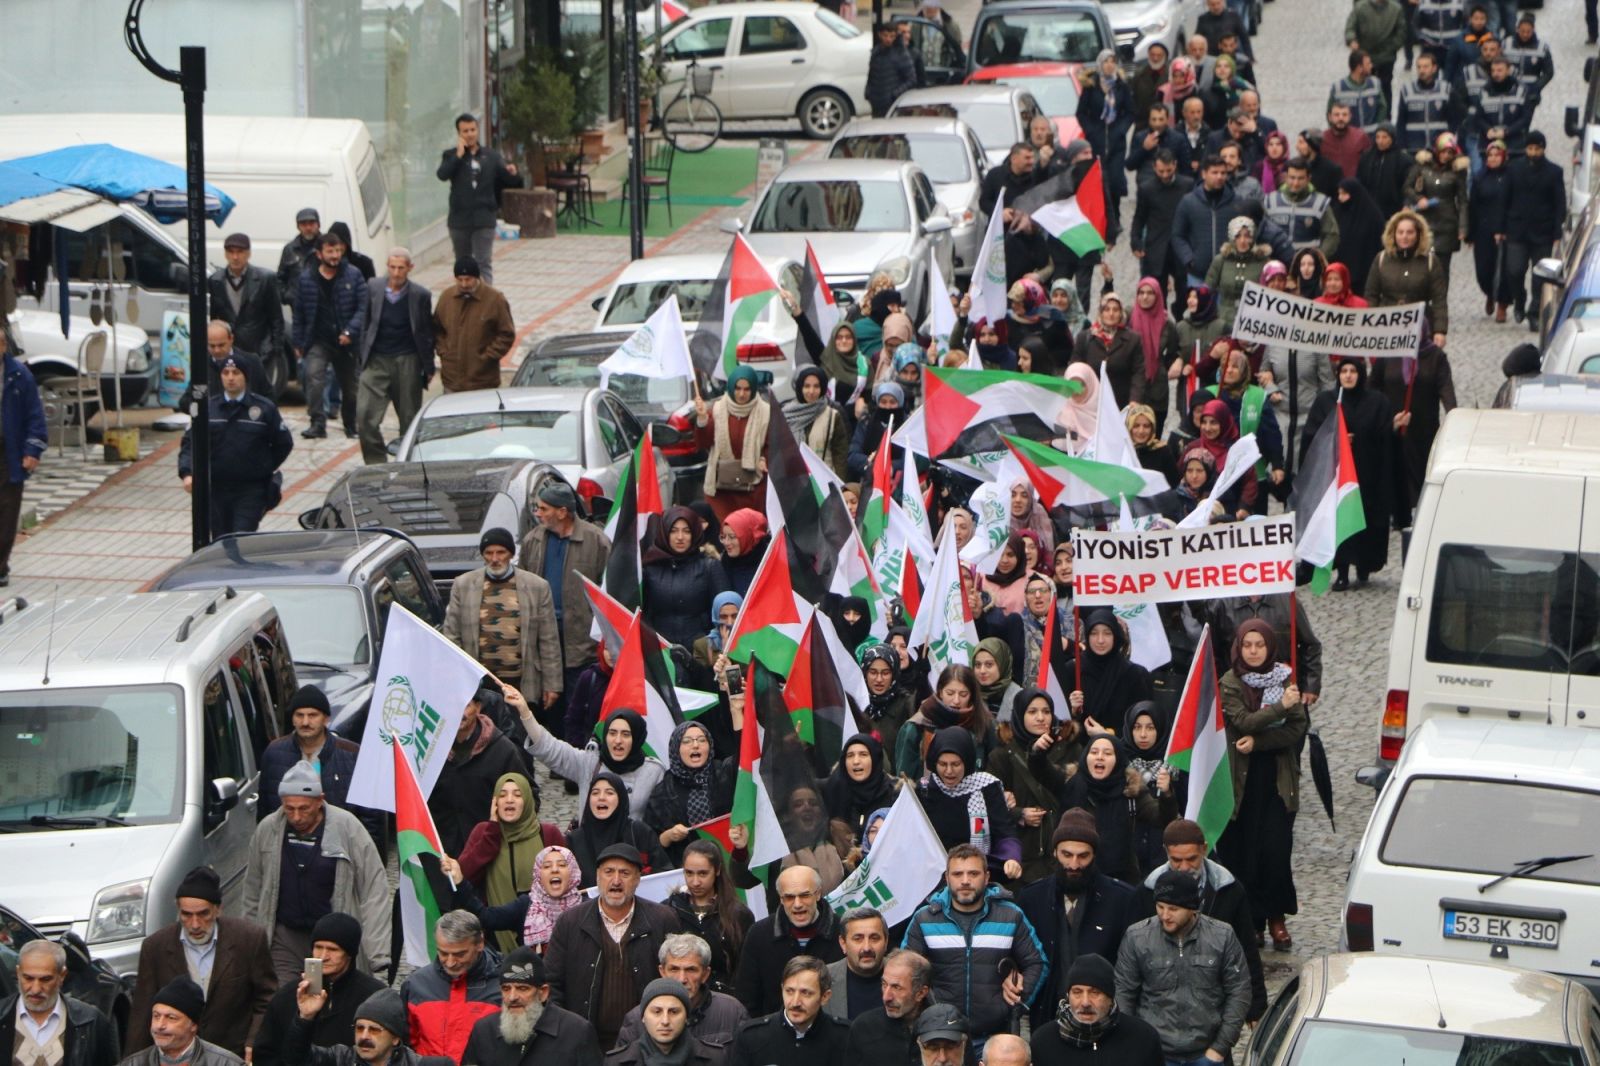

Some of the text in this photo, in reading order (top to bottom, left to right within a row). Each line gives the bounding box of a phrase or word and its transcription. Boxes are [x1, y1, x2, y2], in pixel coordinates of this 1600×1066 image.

[1244, 289, 1419, 330] SİYONİZME KARŞI
[1238, 315, 1417, 350] YAŞASIN İSLAMİ MÜCADELEMİZ
[1071, 523, 1293, 560] İYONİST KATİLLER
[1163, 559, 1294, 590] VERECEK
[1437, 675, 1494, 689] TRANSIT
[1455, 915, 1480, 934] 53
[1487, 918, 1512, 938] EK
[1519, 921, 1557, 942] 390
